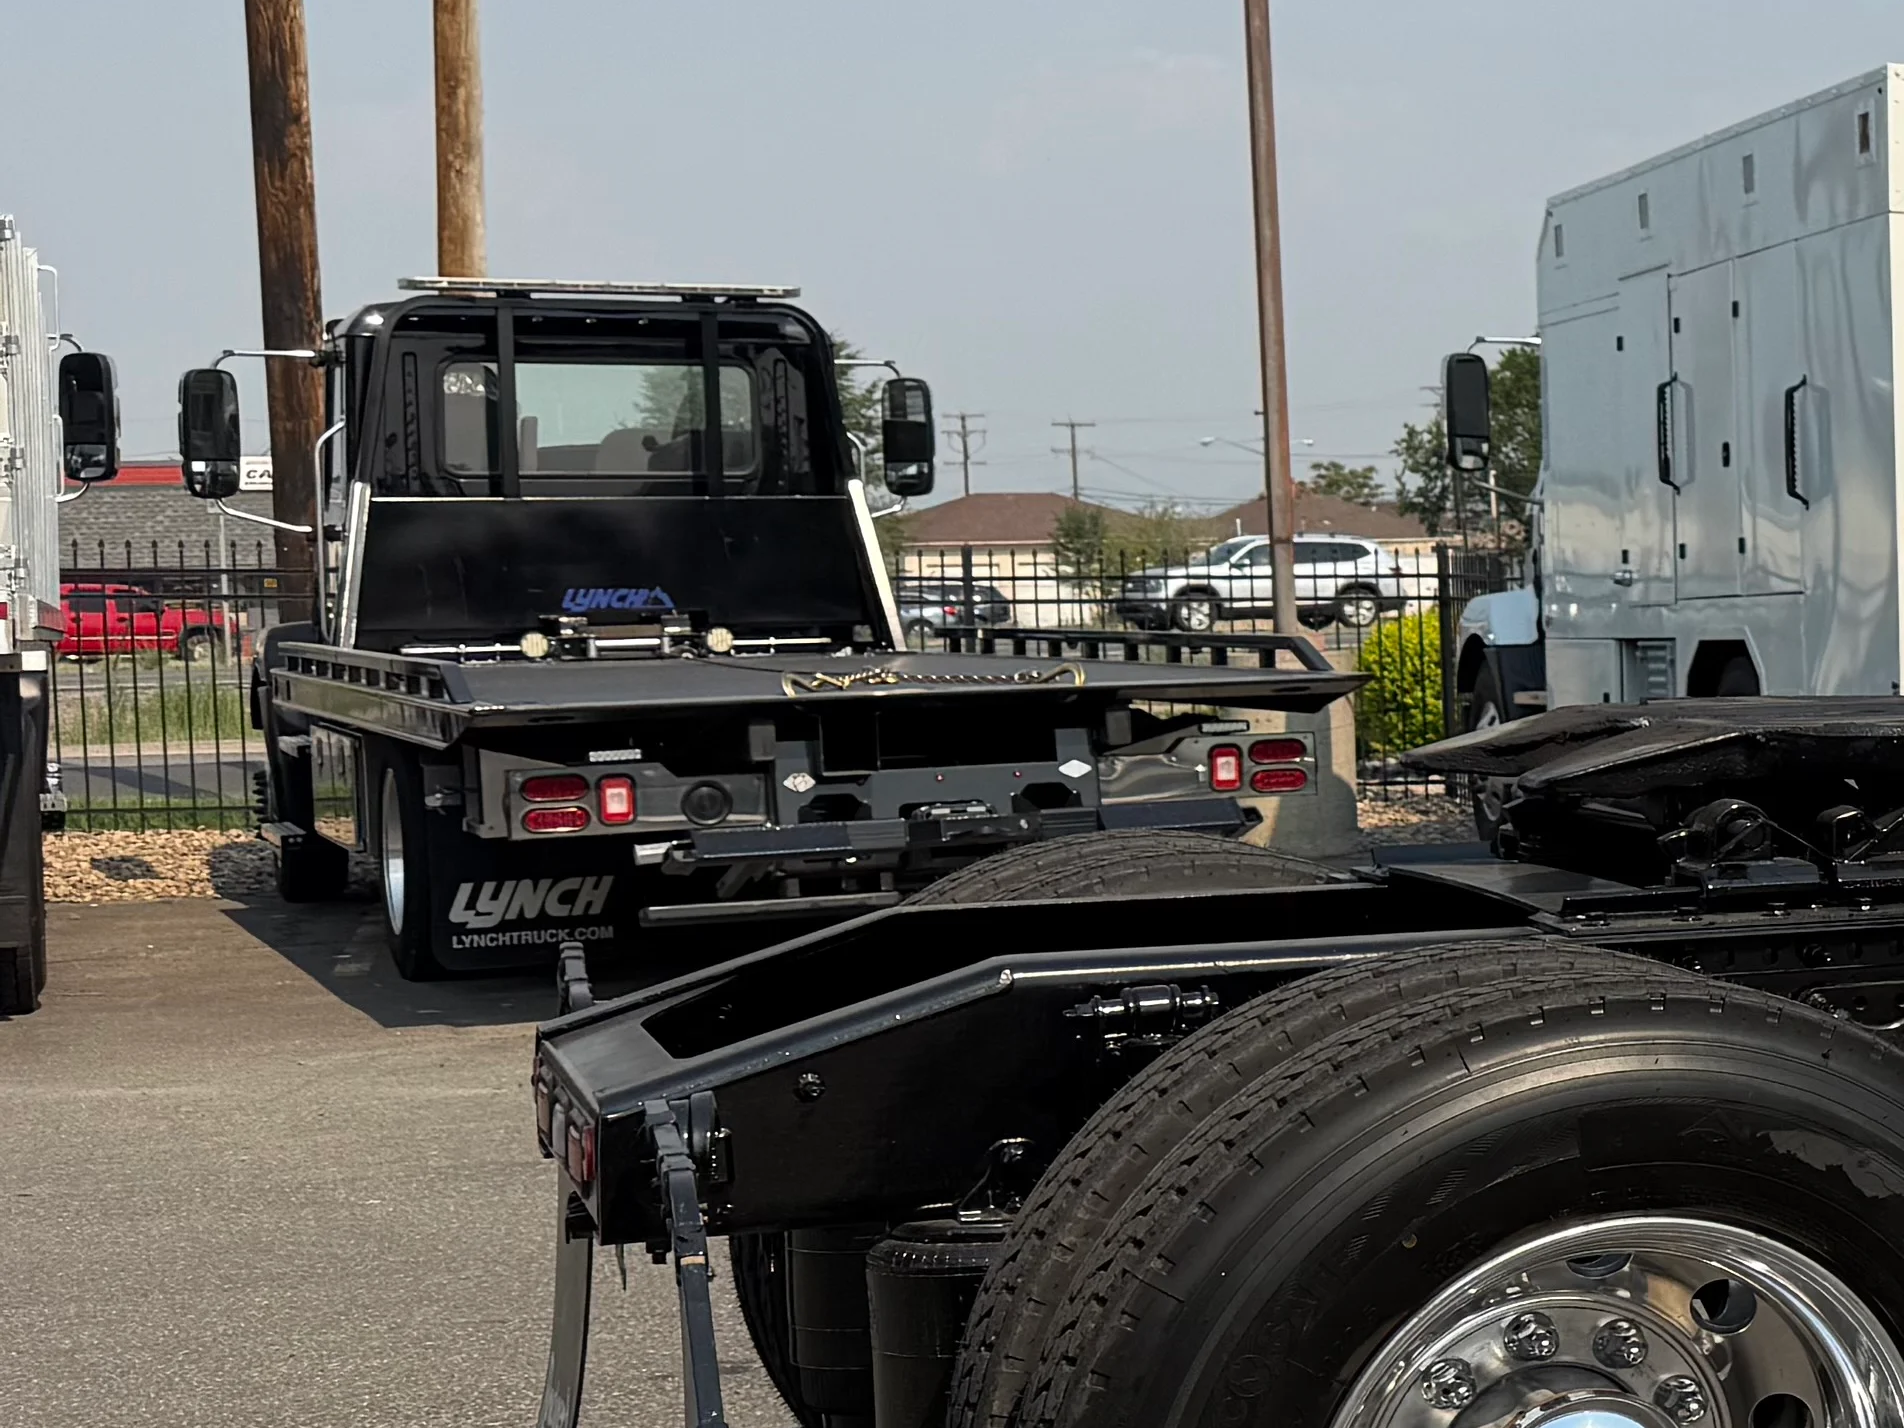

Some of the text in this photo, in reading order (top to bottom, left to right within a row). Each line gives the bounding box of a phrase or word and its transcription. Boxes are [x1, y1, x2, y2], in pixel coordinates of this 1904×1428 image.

[561, 587, 650, 613] LYNCH
[447, 875, 615, 930] LYNCH
[451, 925, 614, 949] LYNCHTRUCK.COM
